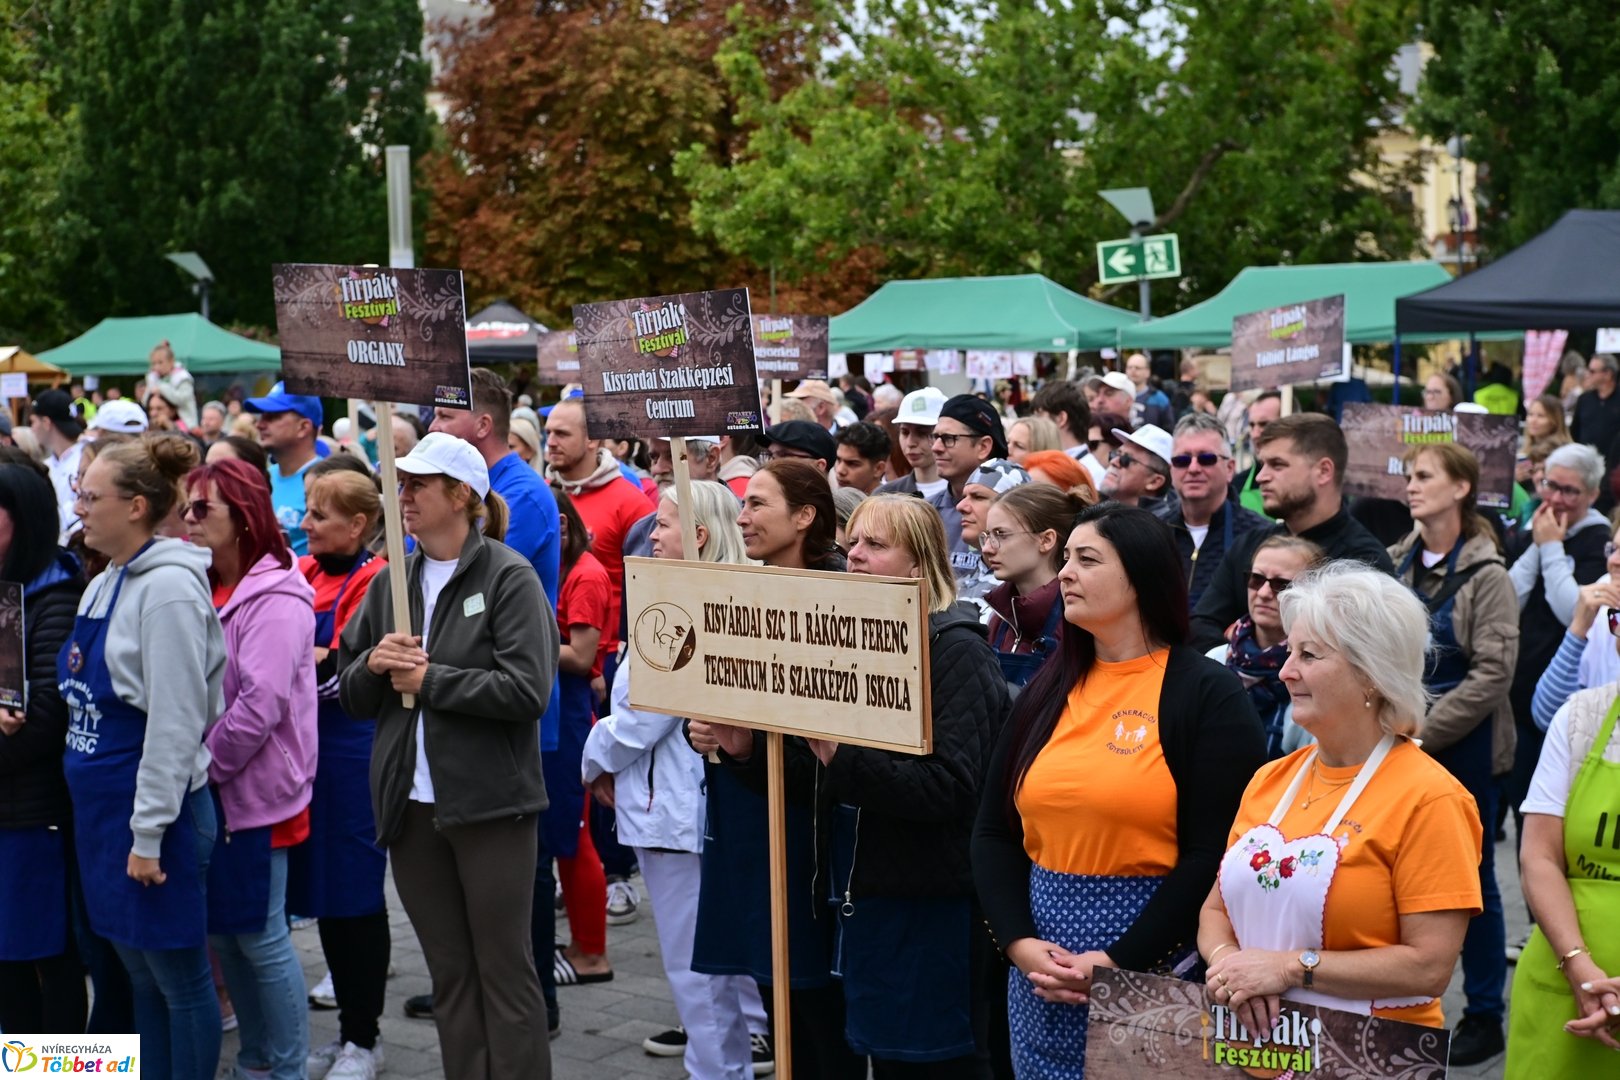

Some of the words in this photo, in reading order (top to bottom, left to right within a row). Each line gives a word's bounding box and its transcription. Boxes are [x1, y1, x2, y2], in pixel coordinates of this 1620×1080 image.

[340, 271, 394, 303] Tirpák
[345, 300, 397, 319] Fesztivál
[632, 302, 681, 337] Tirpák
[347, 339, 405, 366] ORGANX
[639, 328, 685, 354] Fesztivál
[602, 368, 658, 392] Kisvárdai
[660, 363, 734, 390] Szakképzési
[646, 398, 695, 419] Centrum
[1403, 412, 1452, 433] Tirpák
[703, 596, 762, 639] KISVÁRDAI
[765, 608, 786, 642] SZC
[789, 610, 801, 643] II.
[805, 604, 857, 649] RÁKÓCZI
[860, 617, 909, 655] FERENC
[704, 654, 768, 693] TECHNIKUM
[771, 653, 785, 695] ÉS
[789, 660, 858, 704] SZAKKÉPZŐ
[865, 673, 911, 712] ISKOLA
[1214, 1041, 1311, 1073] Fesztivál
